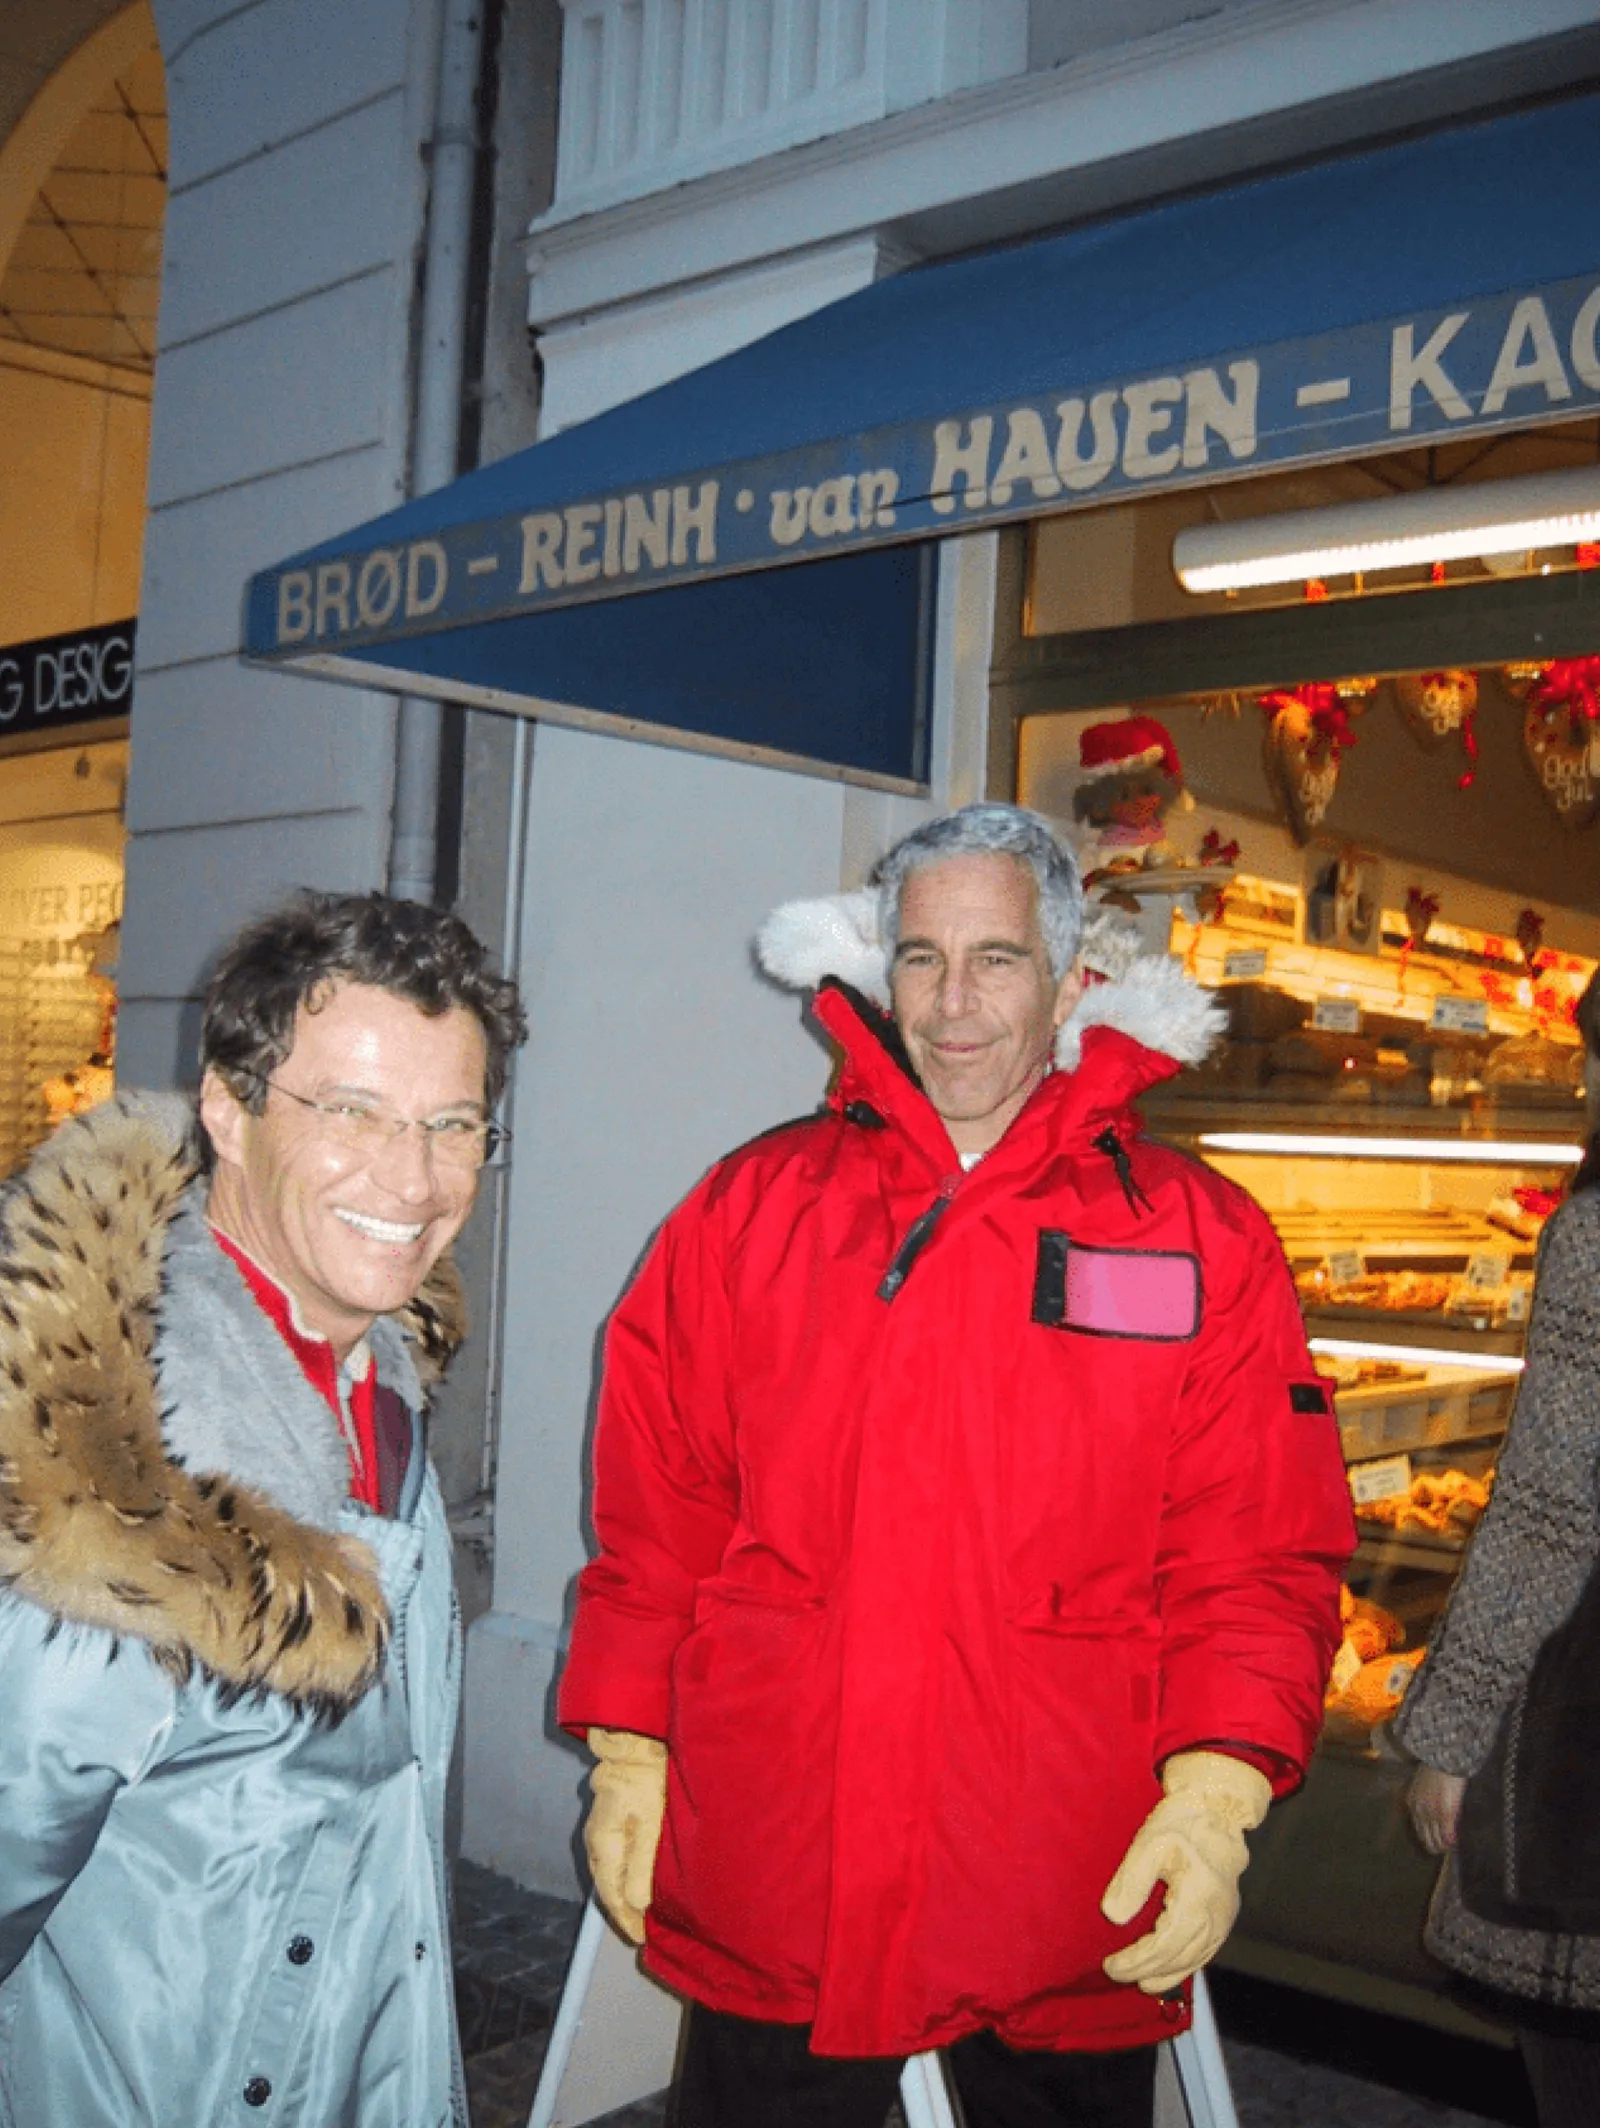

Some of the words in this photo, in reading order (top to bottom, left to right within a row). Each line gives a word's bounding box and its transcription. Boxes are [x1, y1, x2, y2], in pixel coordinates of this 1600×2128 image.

[276, 539, 448, 644] BRØD
[518, 479, 719, 594] REINH
[769, 467, 899, 546] van
